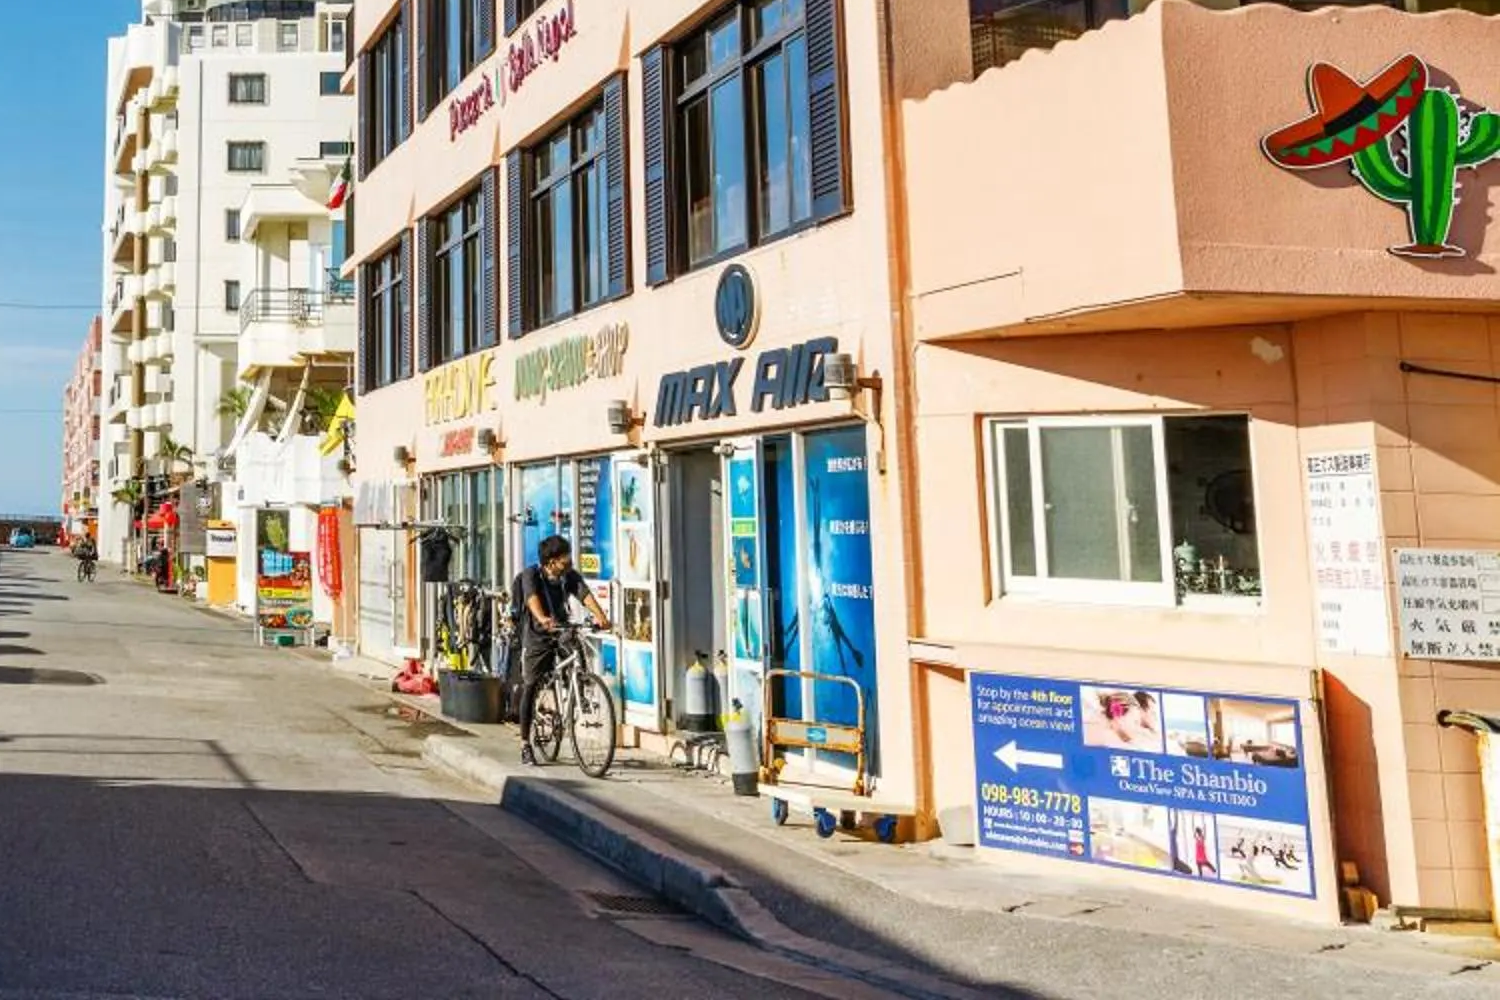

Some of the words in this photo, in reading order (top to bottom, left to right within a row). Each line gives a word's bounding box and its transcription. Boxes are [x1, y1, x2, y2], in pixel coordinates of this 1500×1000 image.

[654, 357, 745, 428] MAX
[751, 336, 838, 412] AIR
[977, 685, 998, 700] Stop
[999, 686, 1011, 701] by
[1013, 688, 1029, 701] the
[1030, 690, 1048, 703] 4th
[1049, 691, 1073, 705] floor
[977, 698, 990, 710] for
[991, 702, 1053, 717] appointment
[1055, 707, 1073, 719] and
[978, 714, 1017, 729] amazing
[1019, 718, 1048, 730] ocean
[1132, 757, 1175, 783] The
[1181, 763, 1268, 796] Shanbio
[981, 782, 1082, 814] 098-983-7778
[1173, 786, 1196, 800] SPA
[1197, 789, 1206, 801] &
[1208, 791, 1258, 808] STUDIO
[983, 805, 1013, 819] HOURS
